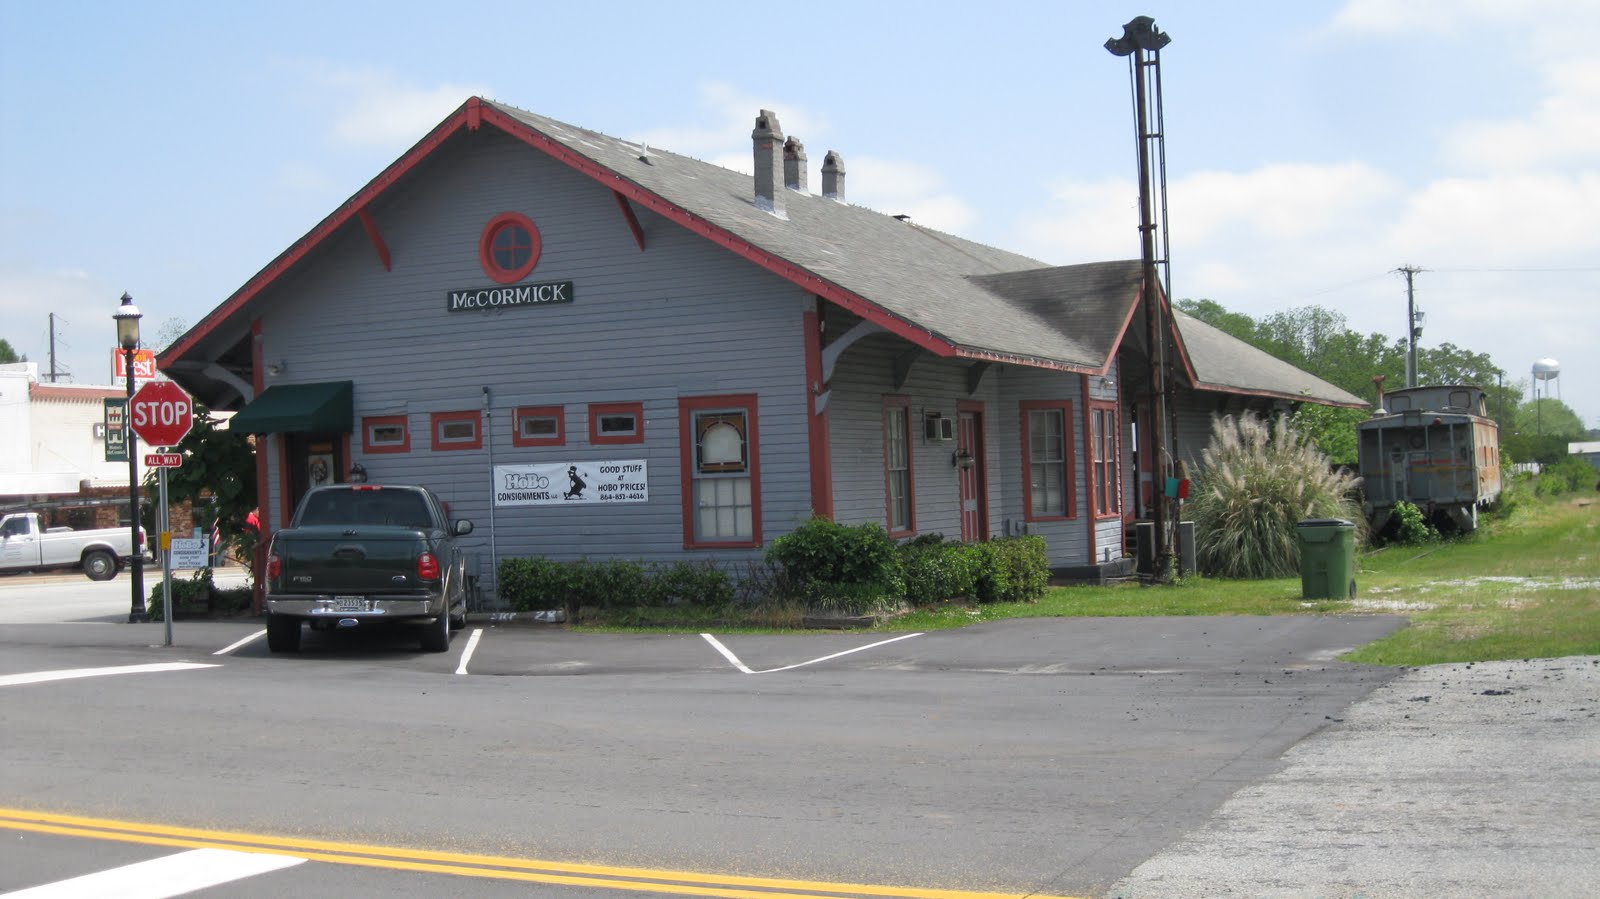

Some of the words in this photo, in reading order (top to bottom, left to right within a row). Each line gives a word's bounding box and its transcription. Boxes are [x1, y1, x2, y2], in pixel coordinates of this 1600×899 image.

[452, 284, 566, 309] McCORMICK
[134, 401, 188, 427] STOP
[148, 456, 161, 465] ALL
[163, 456, 178, 464] WAY
[599, 466, 620, 474] GOOD
[622, 465, 643, 473] STUFF
[598, 484, 618, 492] HOBO
[620, 483, 646, 491] PRICES!
[497, 492, 550, 501] CONSIGNMENTS
